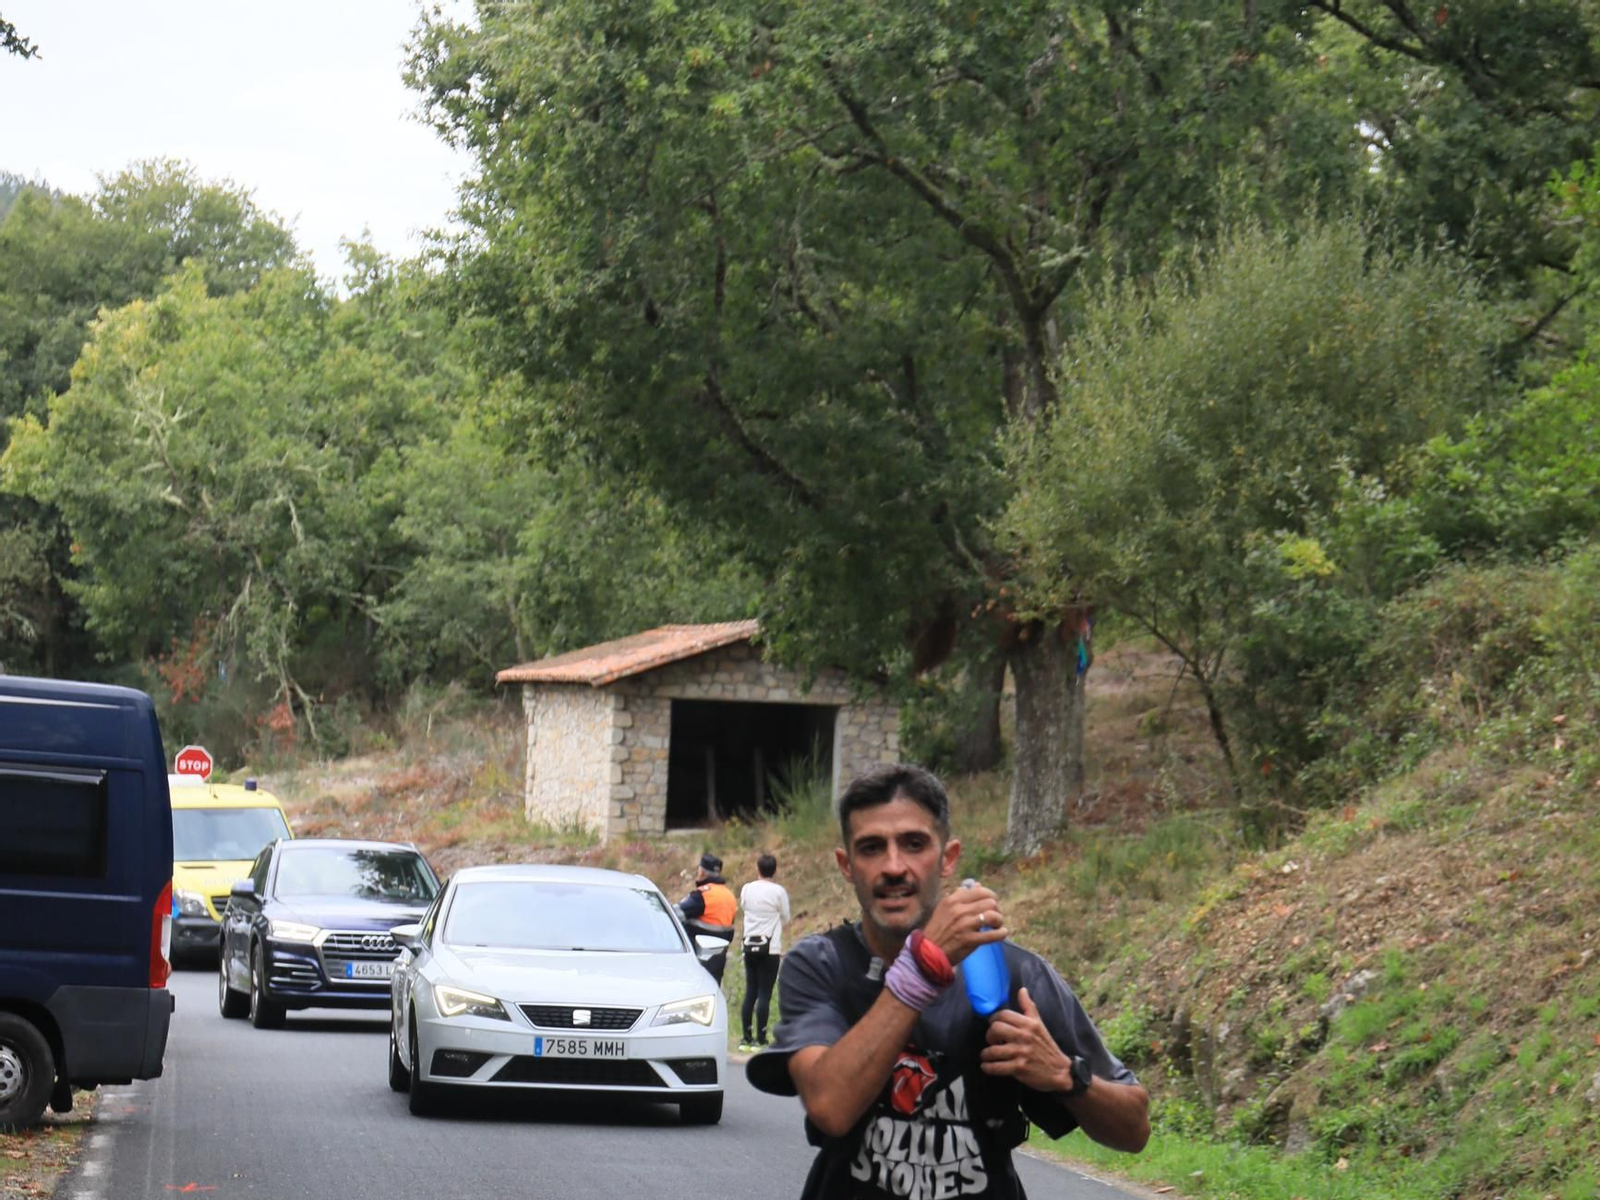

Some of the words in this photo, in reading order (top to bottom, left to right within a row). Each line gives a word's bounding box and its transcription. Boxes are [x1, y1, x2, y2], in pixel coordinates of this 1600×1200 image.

[179, 759, 209, 771] STOP
[355, 964, 383, 975] 4653
[546, 1039, 588, 1055] 7585
[594, 1041, 625, 1057] MMH
